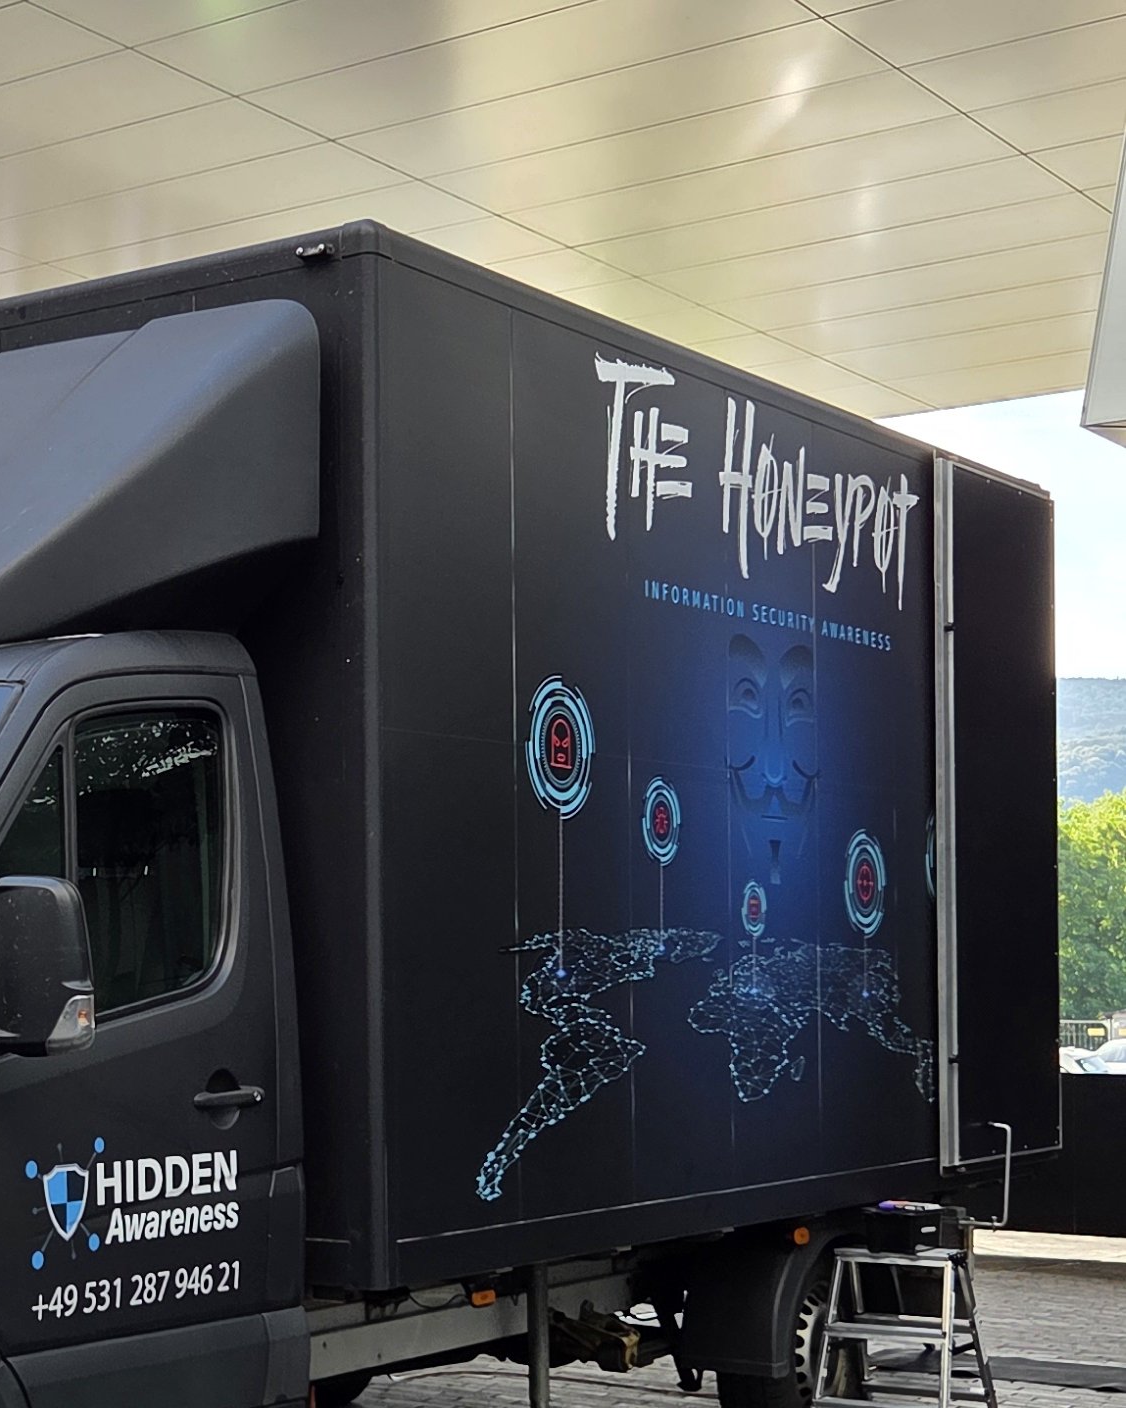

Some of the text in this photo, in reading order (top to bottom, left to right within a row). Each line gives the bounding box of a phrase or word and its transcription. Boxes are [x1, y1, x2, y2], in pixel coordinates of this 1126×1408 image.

[595, 352, 692, 540] THE
[644, 579, 891, 651] INFORMATION SECURITY AWARENESS
[96, 1150, 237, 1206] HIDDEN
[104, 1201, 239, 1245] Awareness
[31, 1260, 240, 1321] +49 531 287 946 21
